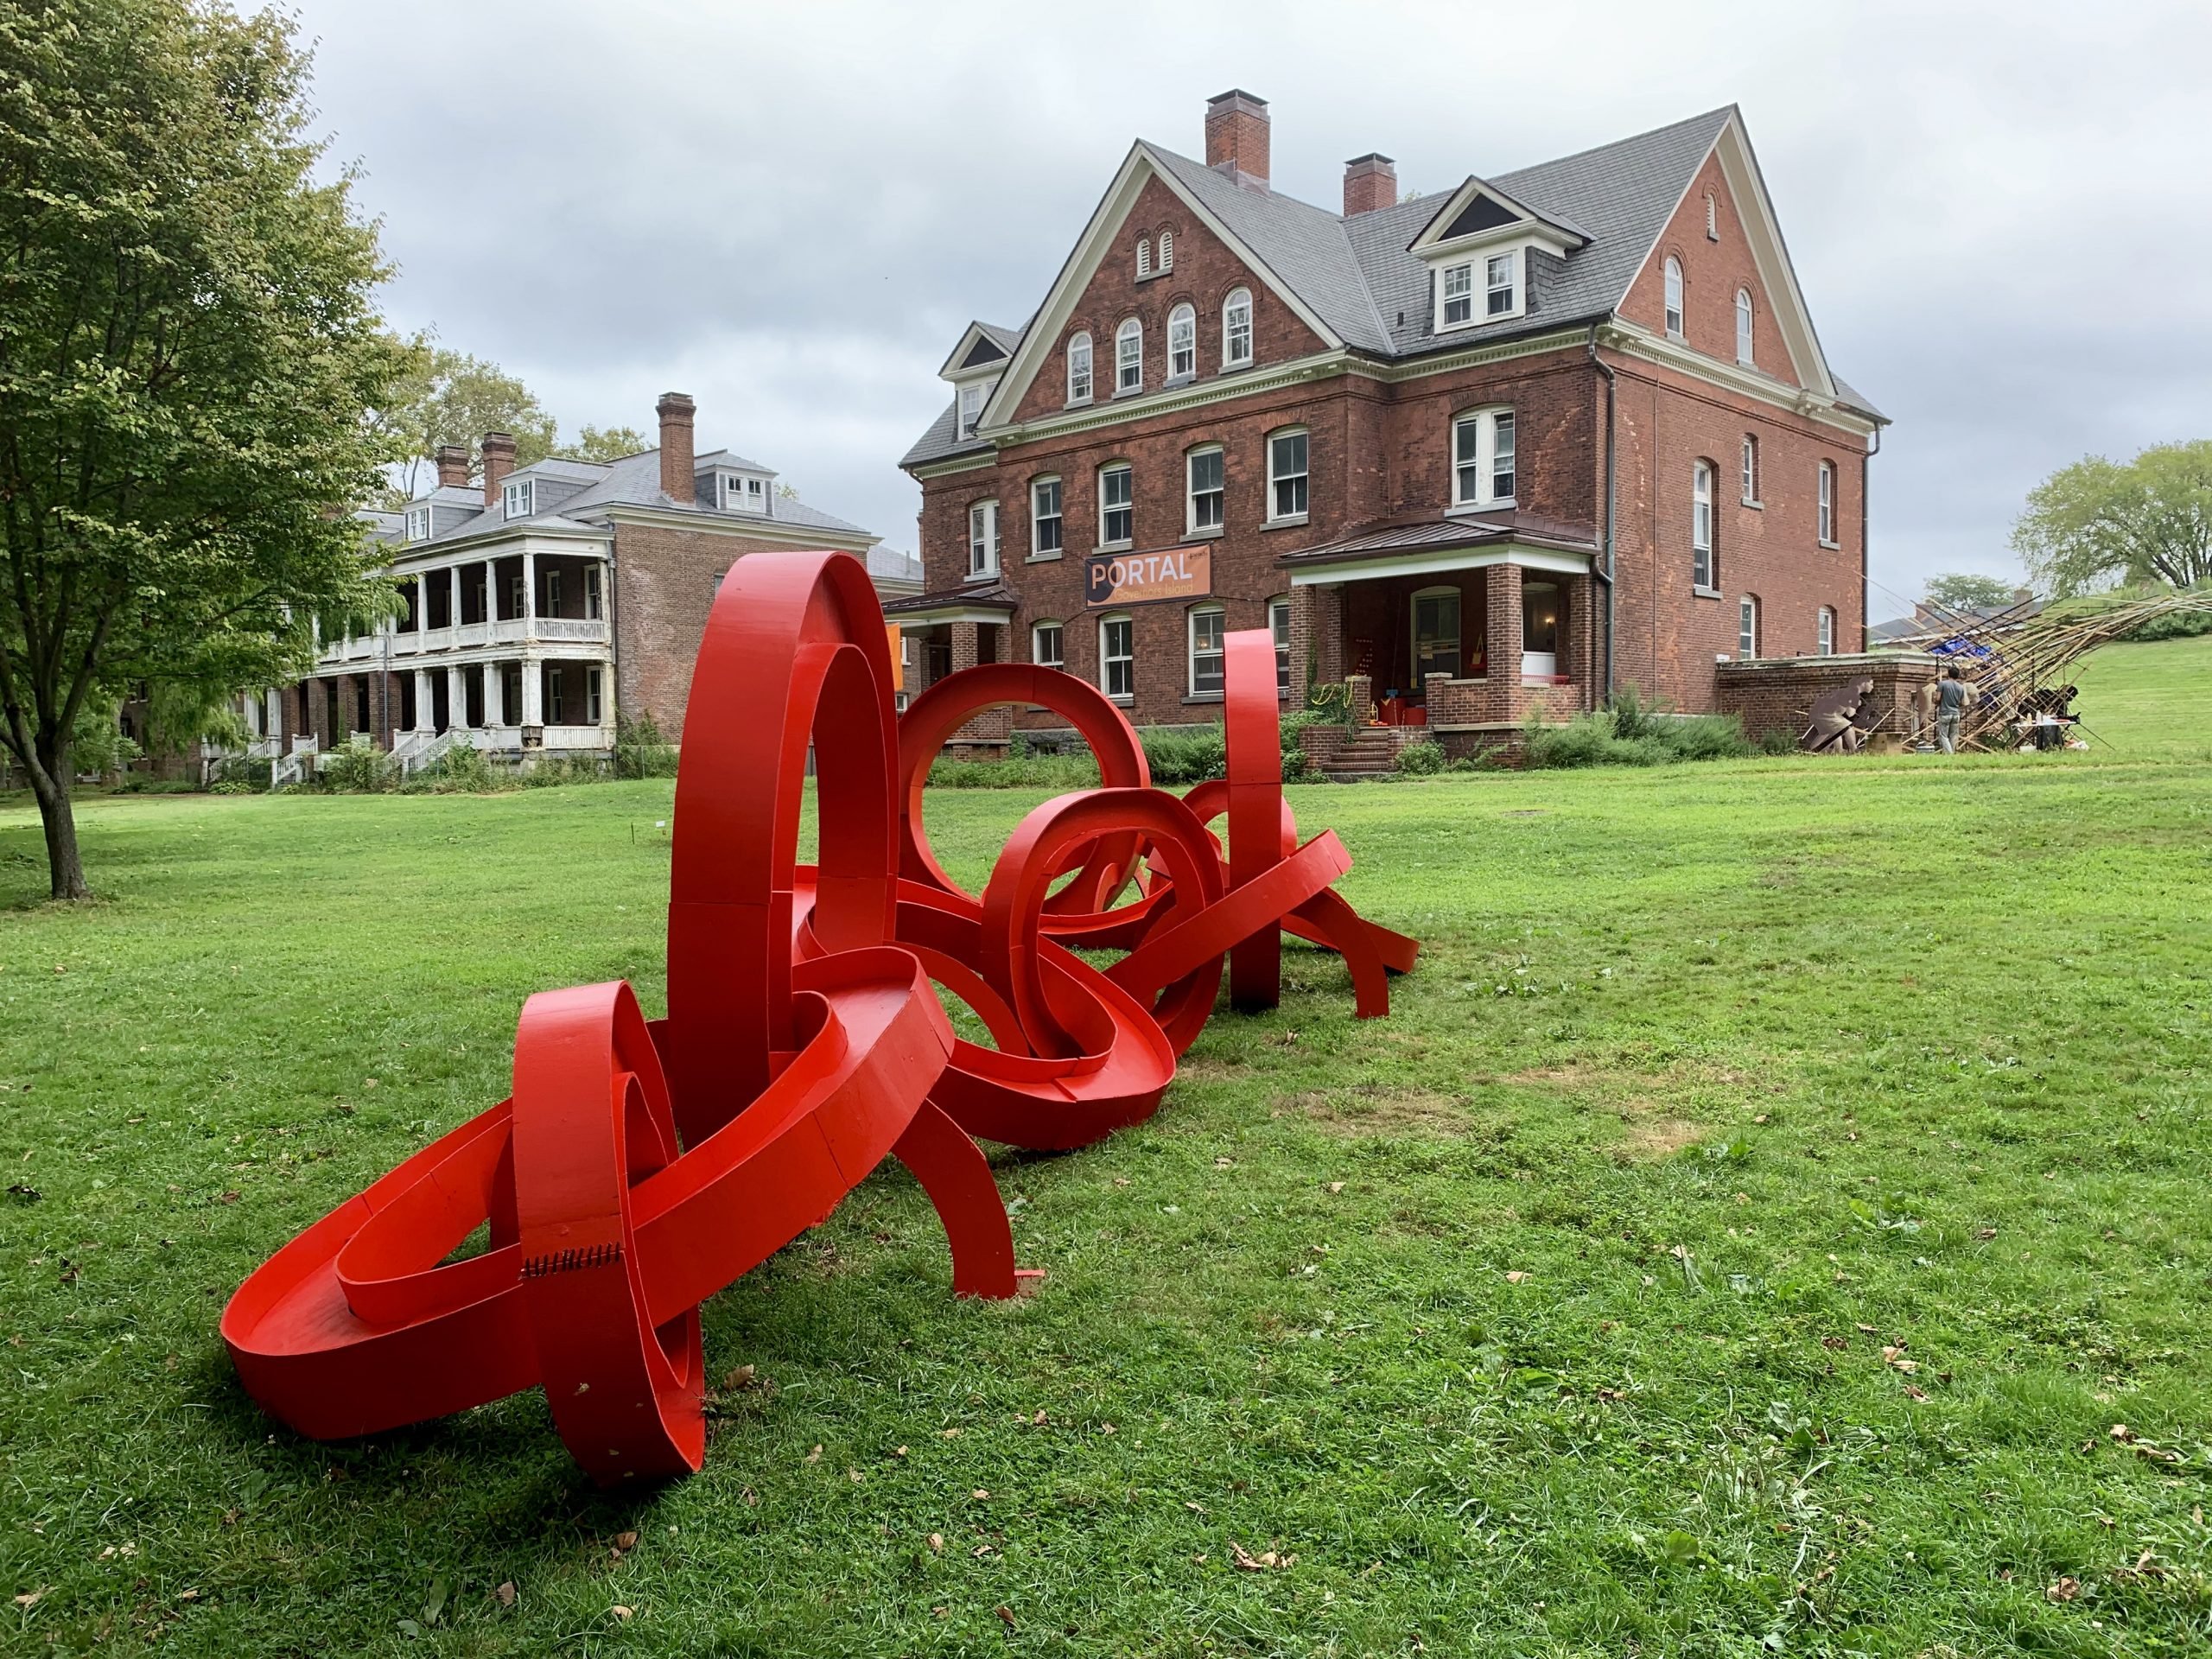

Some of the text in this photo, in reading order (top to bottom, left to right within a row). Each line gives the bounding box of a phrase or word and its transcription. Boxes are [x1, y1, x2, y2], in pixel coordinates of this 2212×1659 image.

[1092, 553, 1192, 589] PORTAL
[1115, 581, 1193, 601] Governors Island
